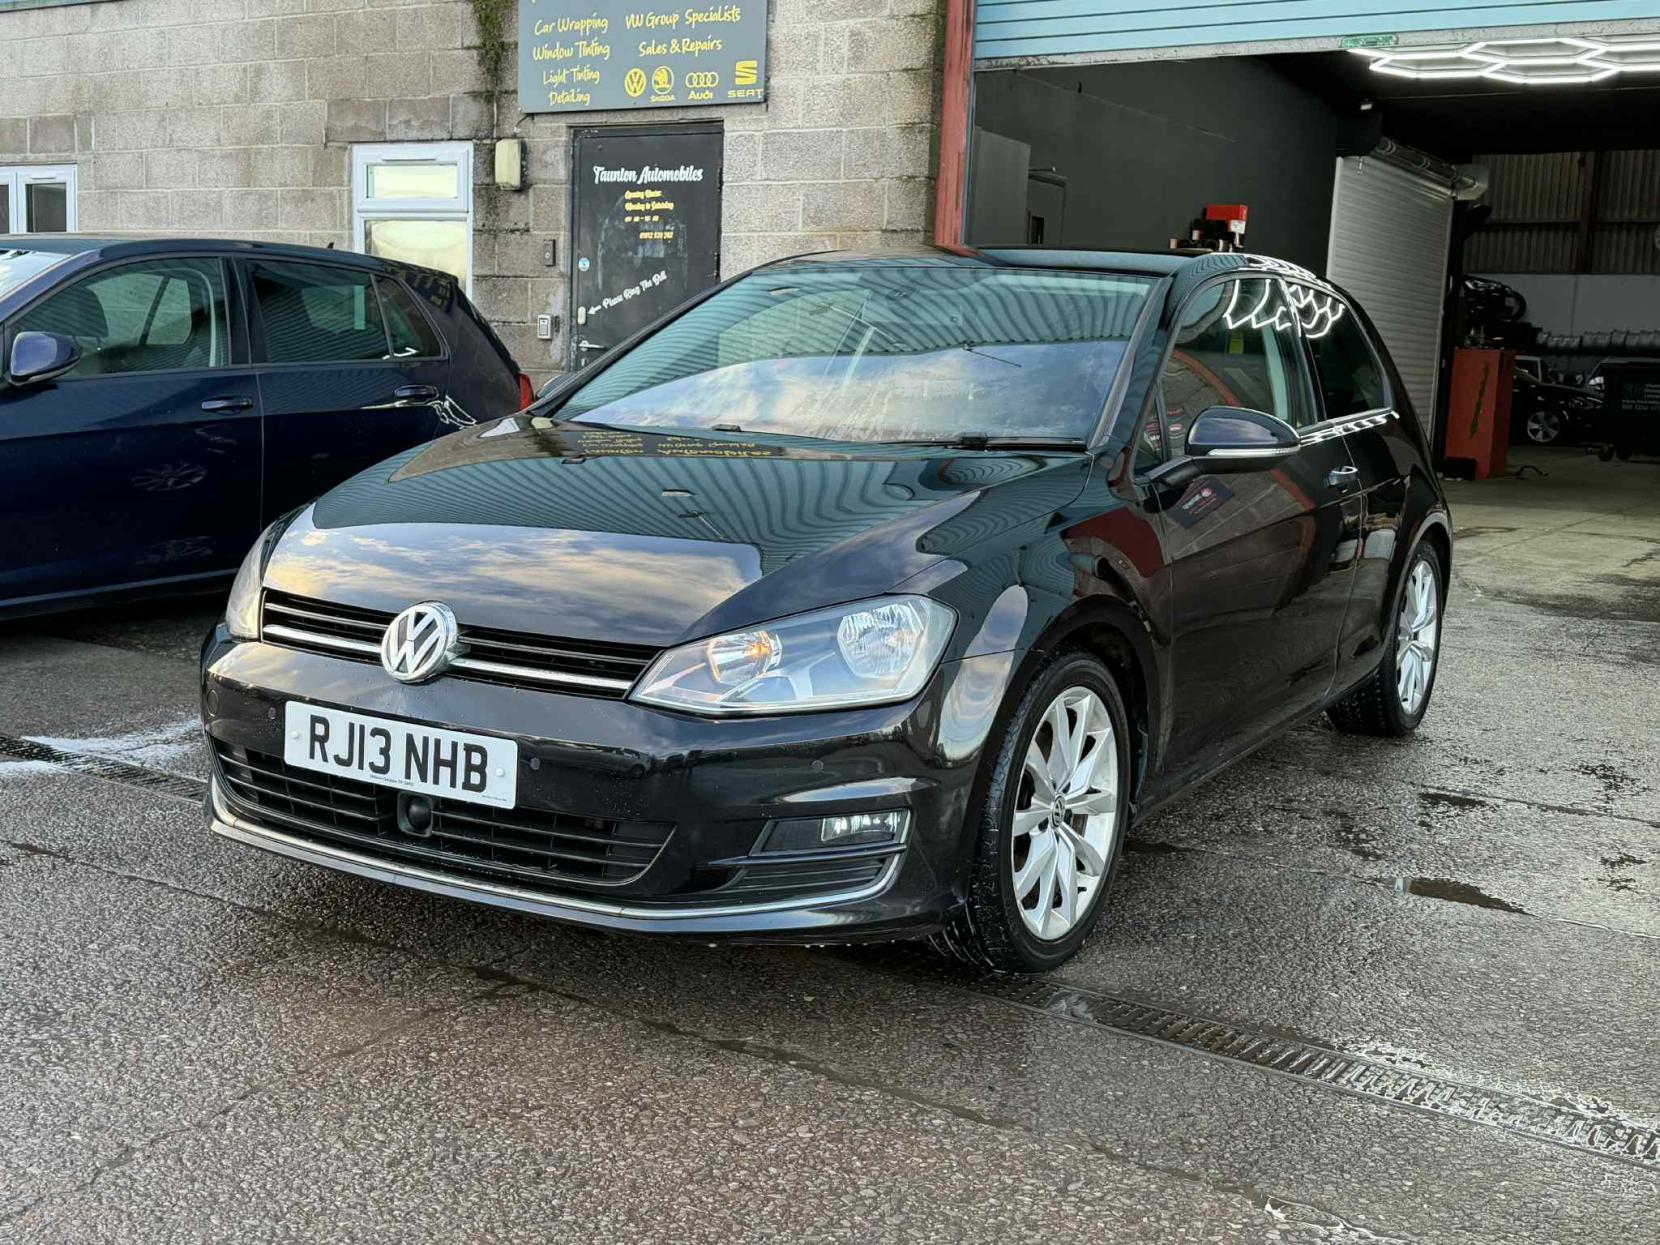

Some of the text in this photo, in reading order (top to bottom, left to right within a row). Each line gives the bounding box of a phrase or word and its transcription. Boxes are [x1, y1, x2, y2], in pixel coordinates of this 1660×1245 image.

[534, 12, 609, 36] Car Wrapping
[625, 13, 643, 30] VW
[645, 11, 679, 30] Group
[532, 36, 610, 61] Window Tinting
[638, 34, 722, 57] Sales & Repairs
[543, 64, 600, 88] Light Tinting
[688, 90, 713, 100] Audi
[727, 88, 764, 99] SEAT
[592, 164, 704, 185] Taunton Automobiles
[602, 294, 624, 309] Please
[623, 286, 641, 300] Ring
[639, 279, 653, 291] The
[309, 714, 488, 793] RJ13 NHB
